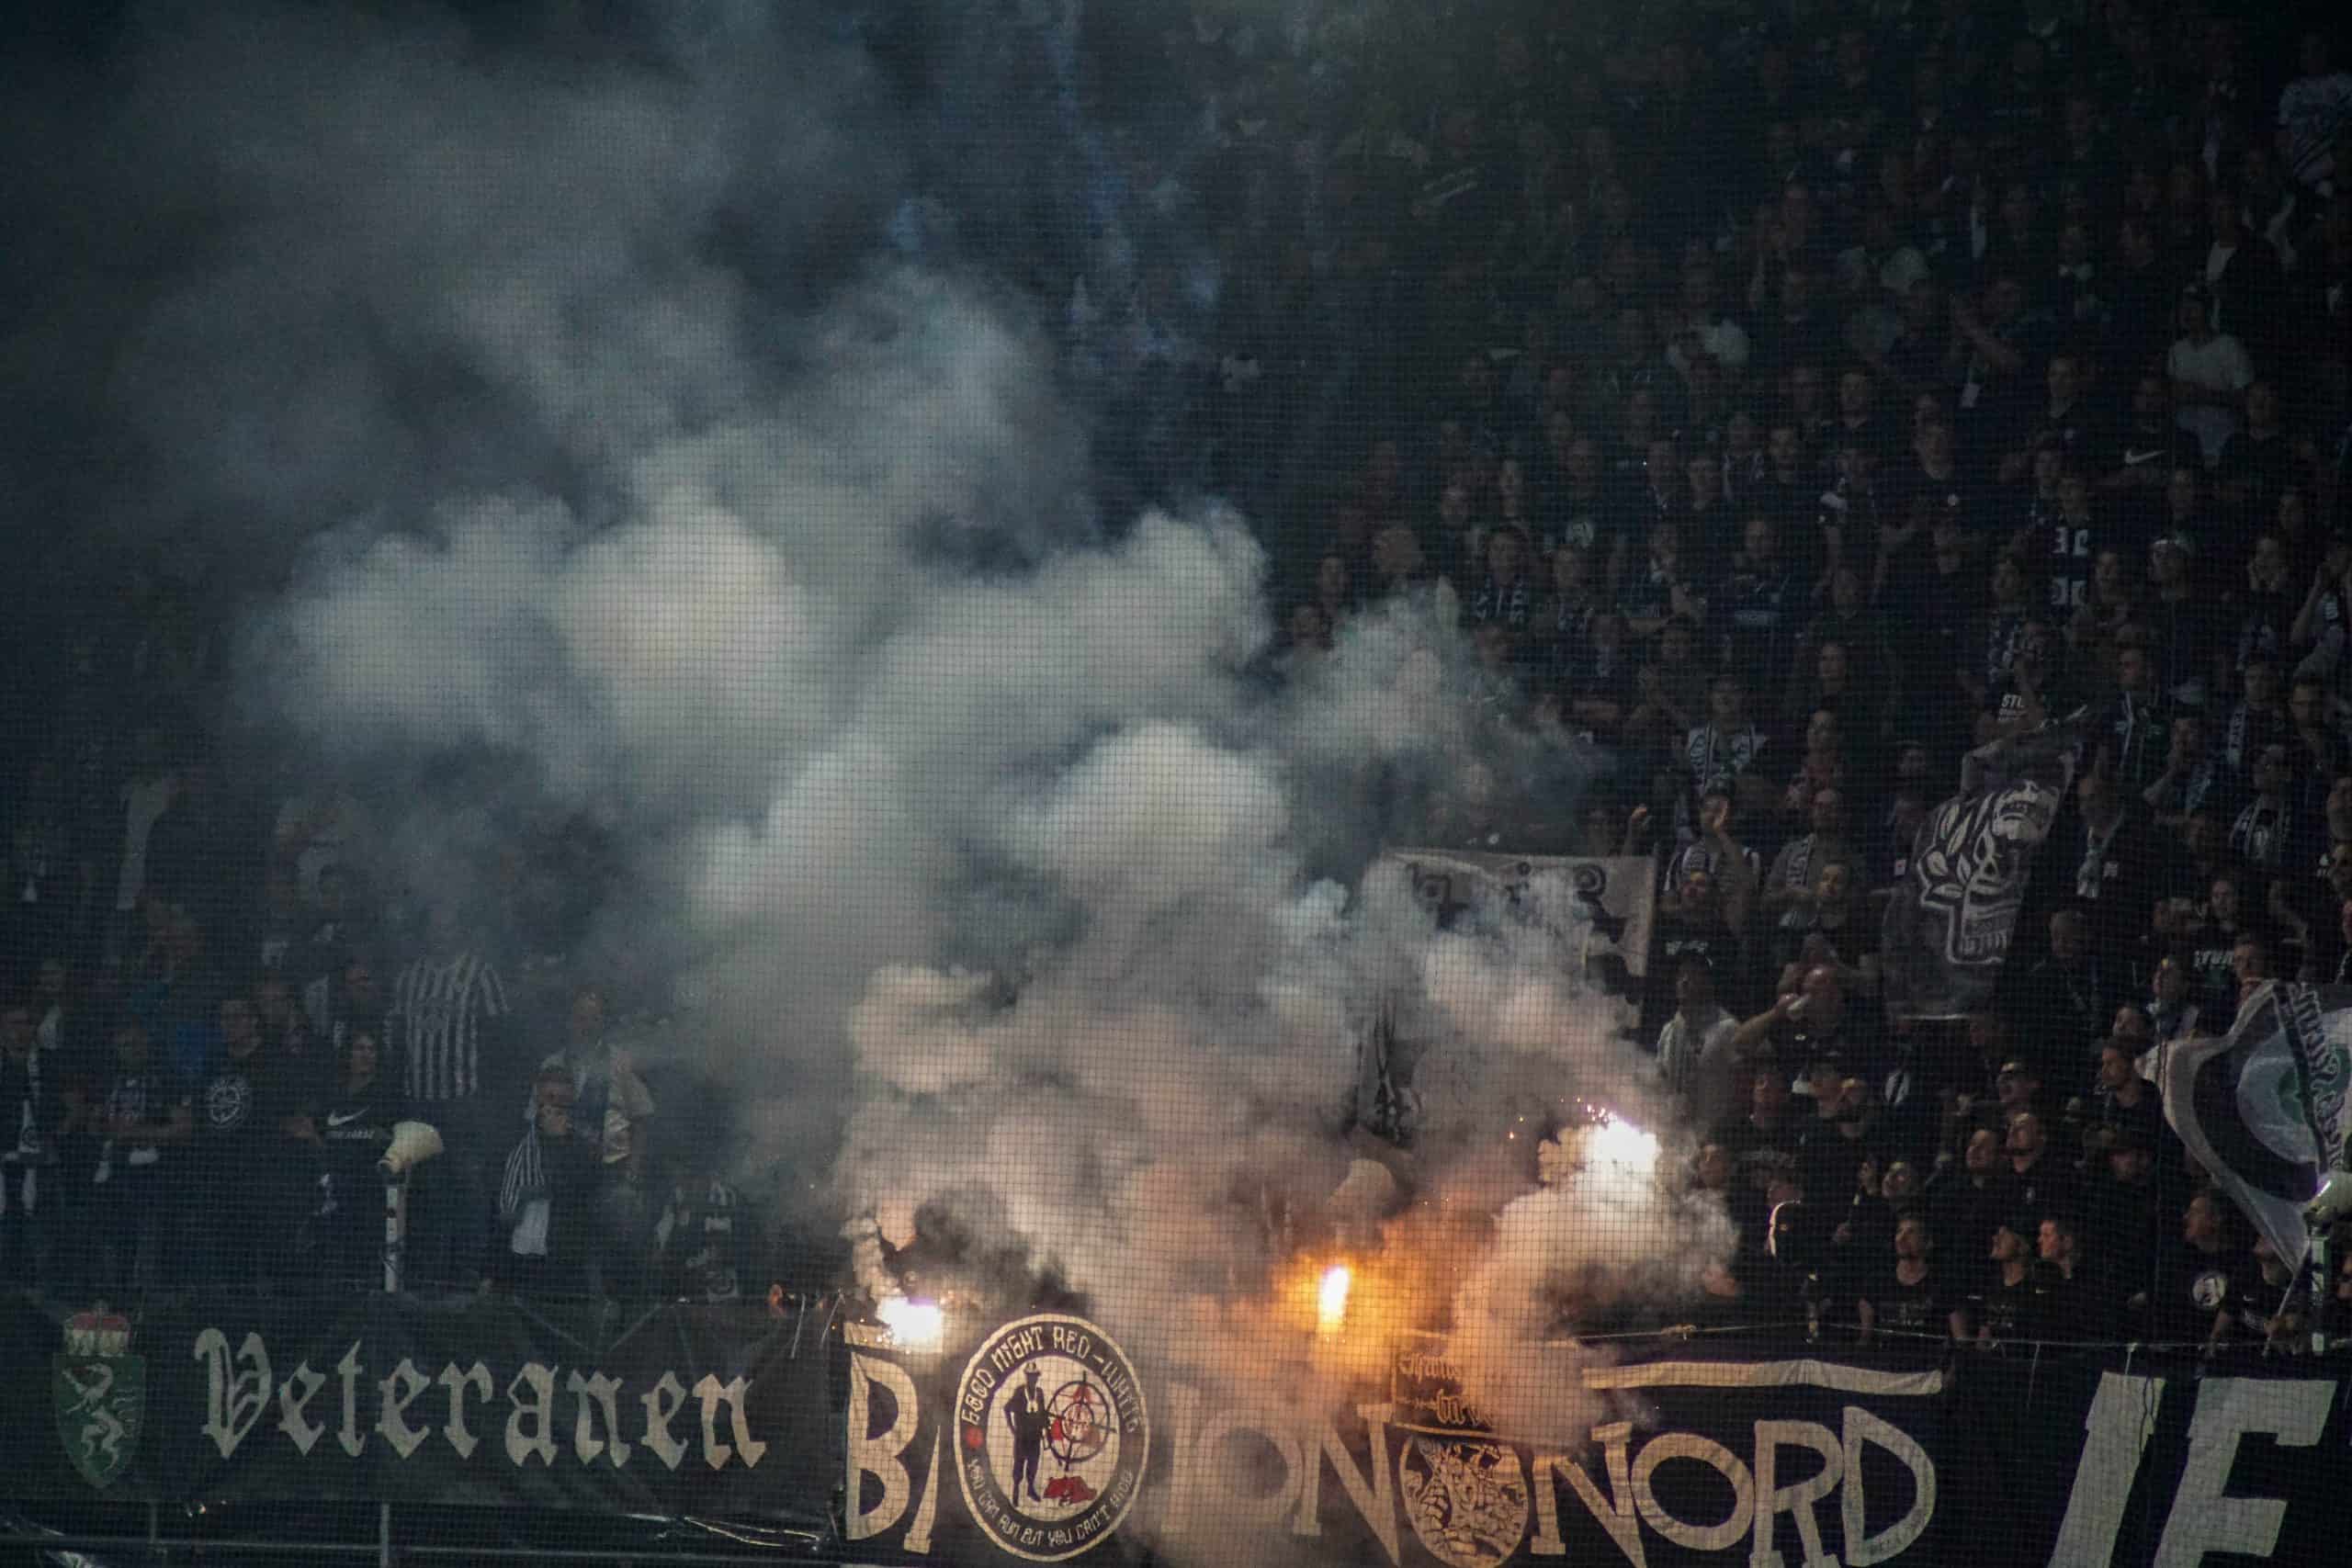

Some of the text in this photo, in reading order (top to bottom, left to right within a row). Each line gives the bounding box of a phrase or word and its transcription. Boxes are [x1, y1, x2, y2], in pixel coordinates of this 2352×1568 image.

[194, 1327, 767, 1470] Veteranen
[961, 1369, 996, 1426] GOOD
[990, 1325, 1044, 1373] NIGHT
[1047, 1528, 1073, 1548] YOU
[1529, 1405, 1938, 1568] NORD
